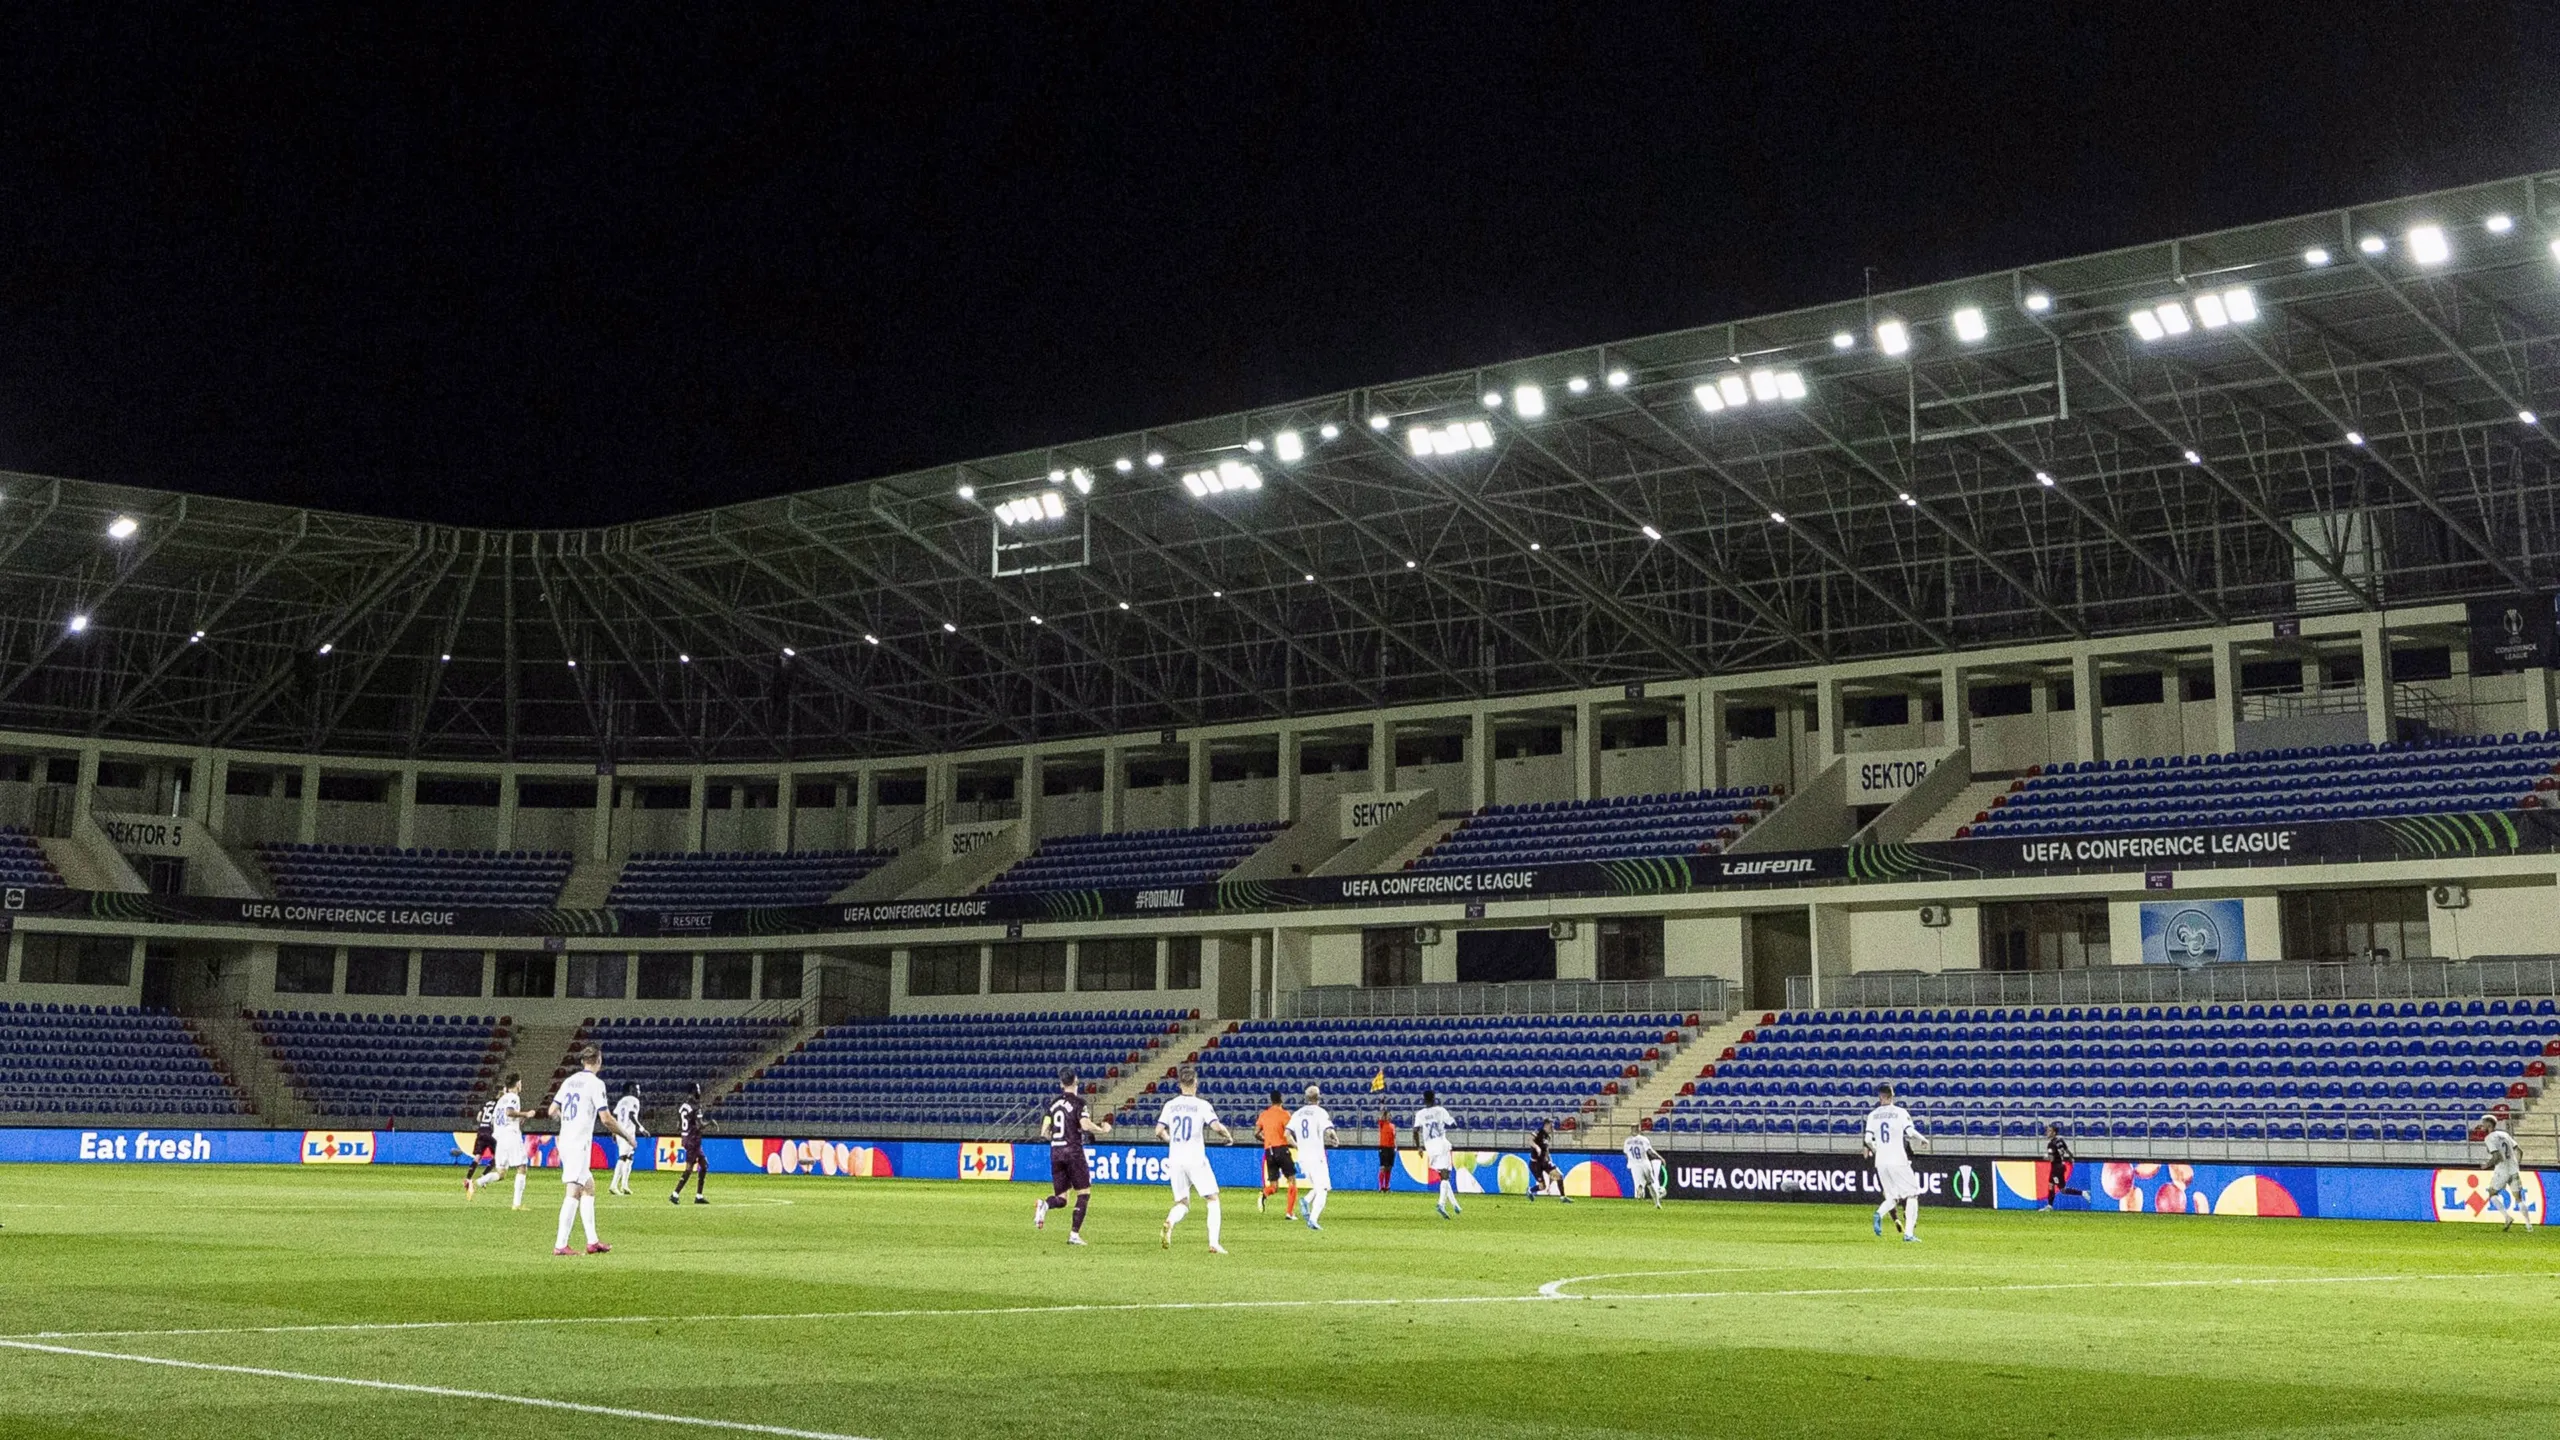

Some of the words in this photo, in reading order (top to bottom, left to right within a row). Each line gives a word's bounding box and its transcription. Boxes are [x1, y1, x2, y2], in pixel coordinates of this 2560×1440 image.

[1861, 761, 1927, 790] SEKTOR
[1353, 801, 1404, 827] SEKTO
[107, 822, 166, 846] SEKTOR
[172, 826, 182, 846] 5
[2022, 842, 2072, 862] UEFA
[2077, 836, 2205, 860] CONFERENCE
[2211, 831, 2291, 854] LEAGUE
[1342, 880, 1379, 897] UEFA
[1381, 874, 1473, 895] CONFERENCE
[1476, 871, 1533, 890] LEAGUE
[844, 907, 871, 921] UEFA
[873, 903, 942, 920] CONFERENCE
[944, 901, 987, 917] LEAGUE
[1135, 889, 1185, 909] #FOOTBALL
[241, 904, 281, 919] UEFA
[284, 906, 386, 924] CONFERENCE
[391, 911, 454, 925] LEAGUE
[673, 915, 713, 926] RESPECT
[563, 1093, 580, 1121] 26
[681, 1111, 689, 1131] 6
[1053, 1110, 1065, 1139] 9
[1173, 1116, 1192, 1142] 20
[1302, 1119, 1309, 1139] 8
[1881, 1122, 1890, 1144] 6
[79, 1132, 127, 1159] Eat
[135, 1131, 211, 1160] fresh
[1086, 1148, 1121, 1181] Eat
[1126, 1148, 1171, 1181] fres
[1677, 1167, 1727, 1190] UEFA
